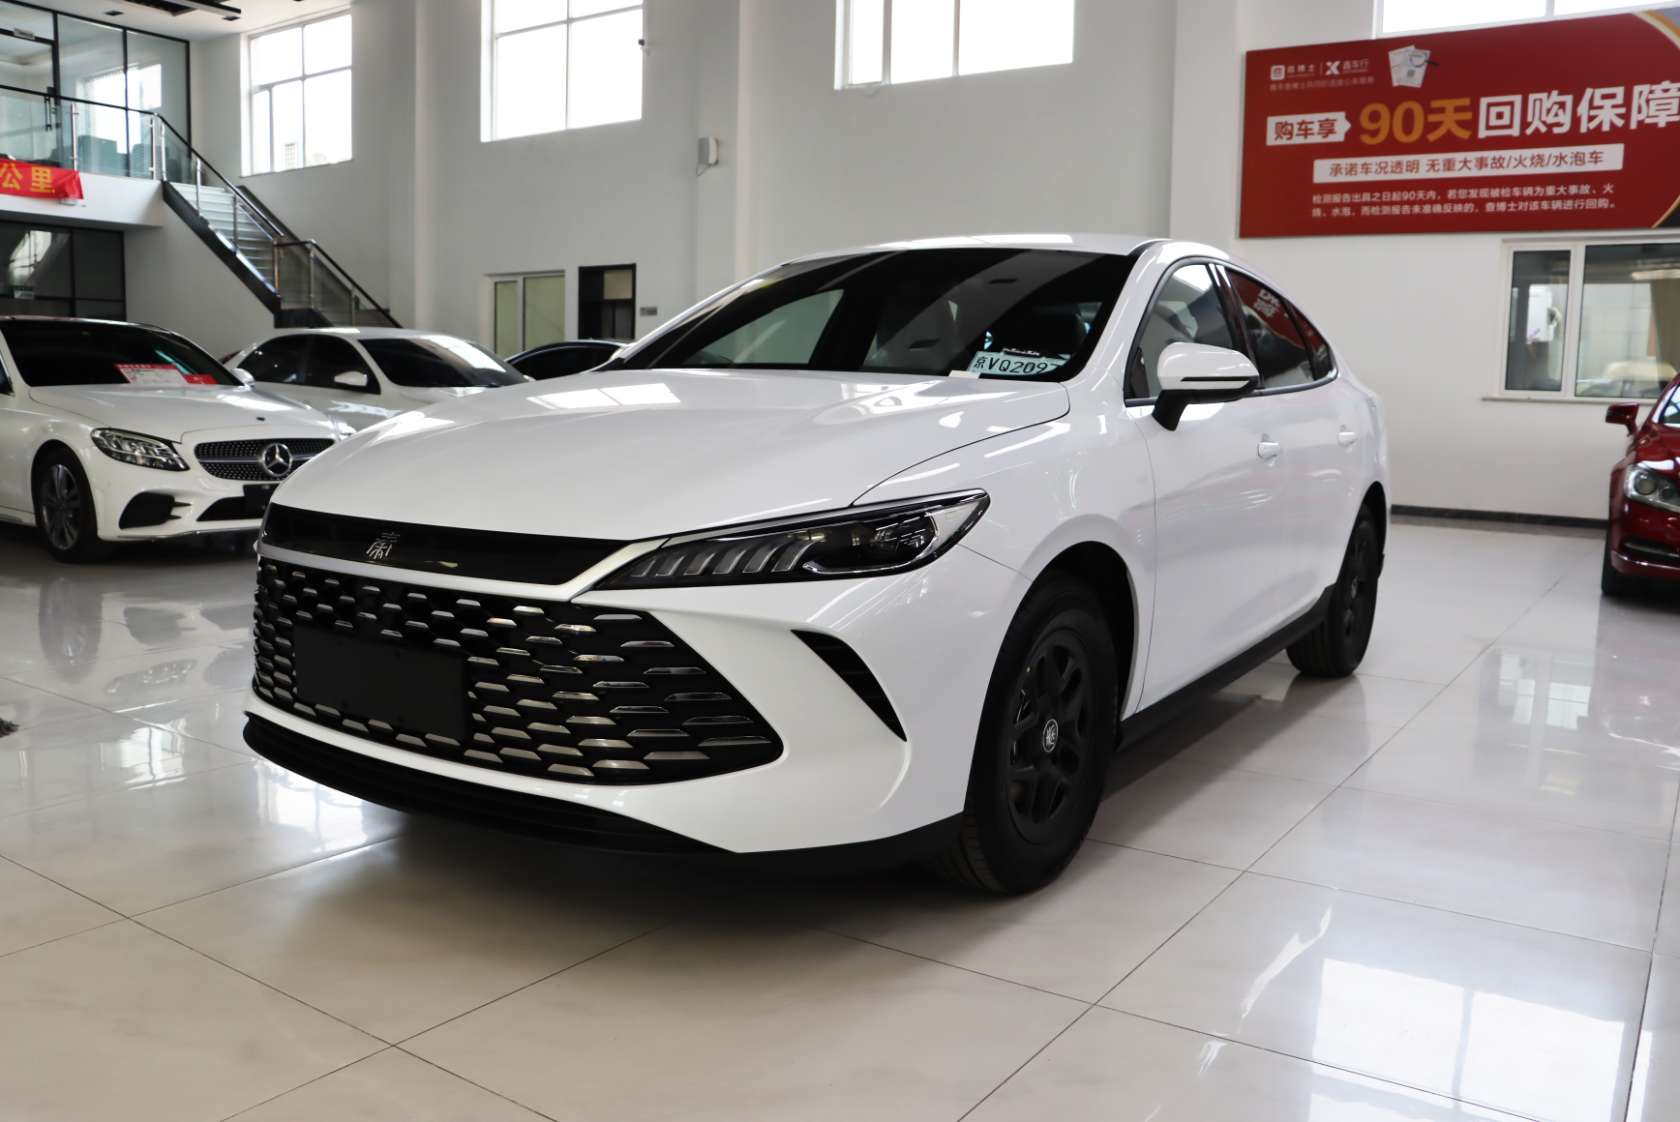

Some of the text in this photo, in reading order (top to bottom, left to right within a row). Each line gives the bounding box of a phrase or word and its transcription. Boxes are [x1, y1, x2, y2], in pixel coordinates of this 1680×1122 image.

[1274, 117, 1337, 141] 购车享
[1329, 150, 1604, 177] 承诺车况透明 无重大事故/火烧/水泡车
[0, 162, 54, 193] 公里
